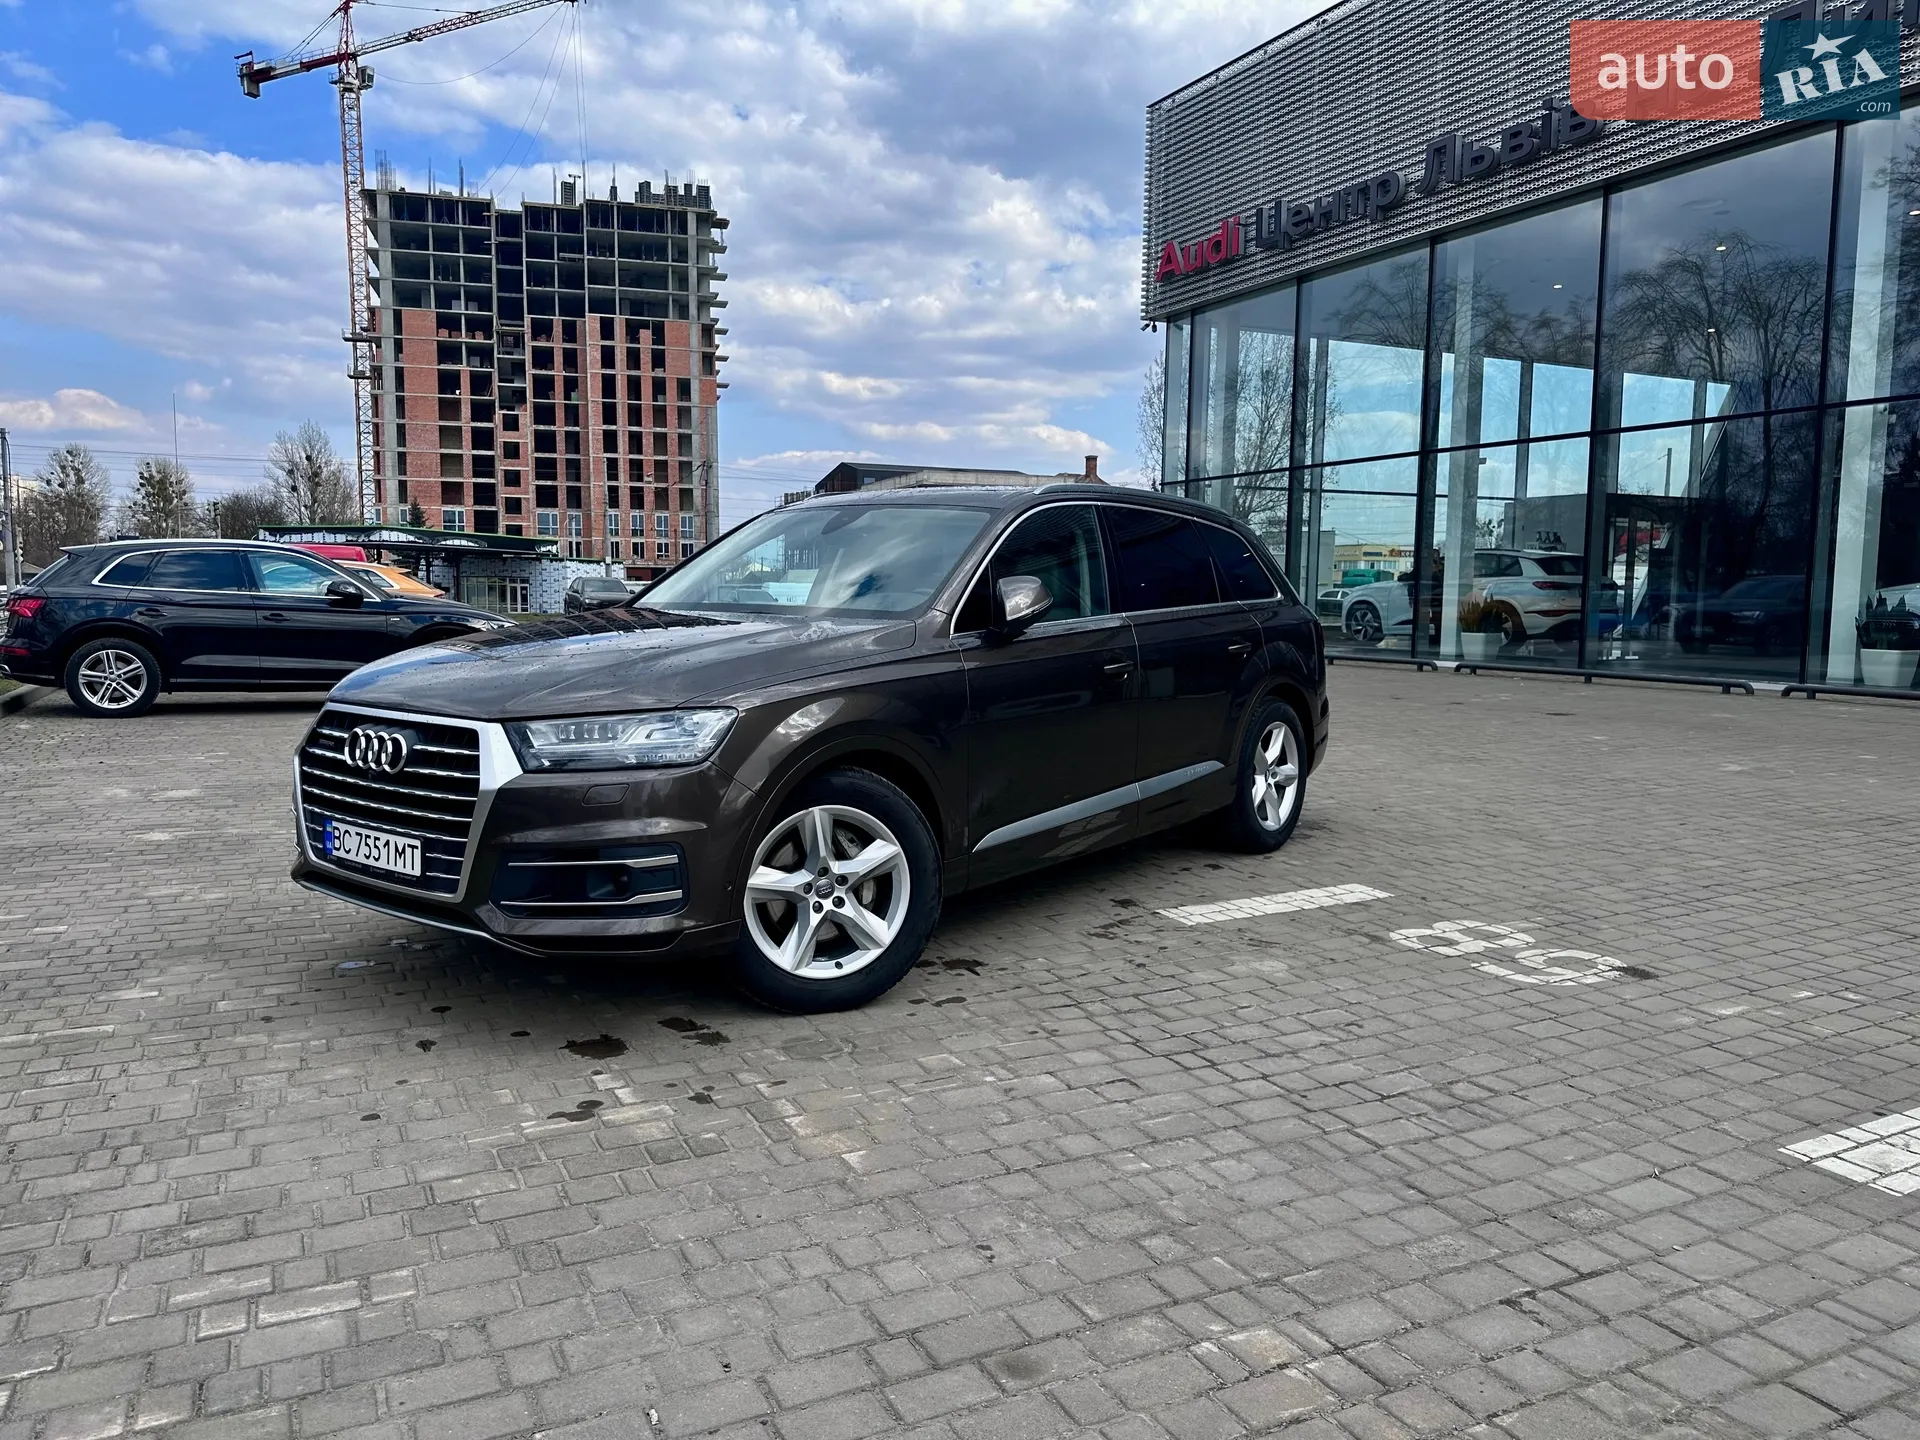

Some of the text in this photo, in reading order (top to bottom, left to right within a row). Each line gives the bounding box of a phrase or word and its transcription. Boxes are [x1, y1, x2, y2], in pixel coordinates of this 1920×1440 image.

[1155, 215, 1242, 281] Audi
[1256, 170, 1403, 249] Центр
[1415, 98, 1600, 194] Львів
